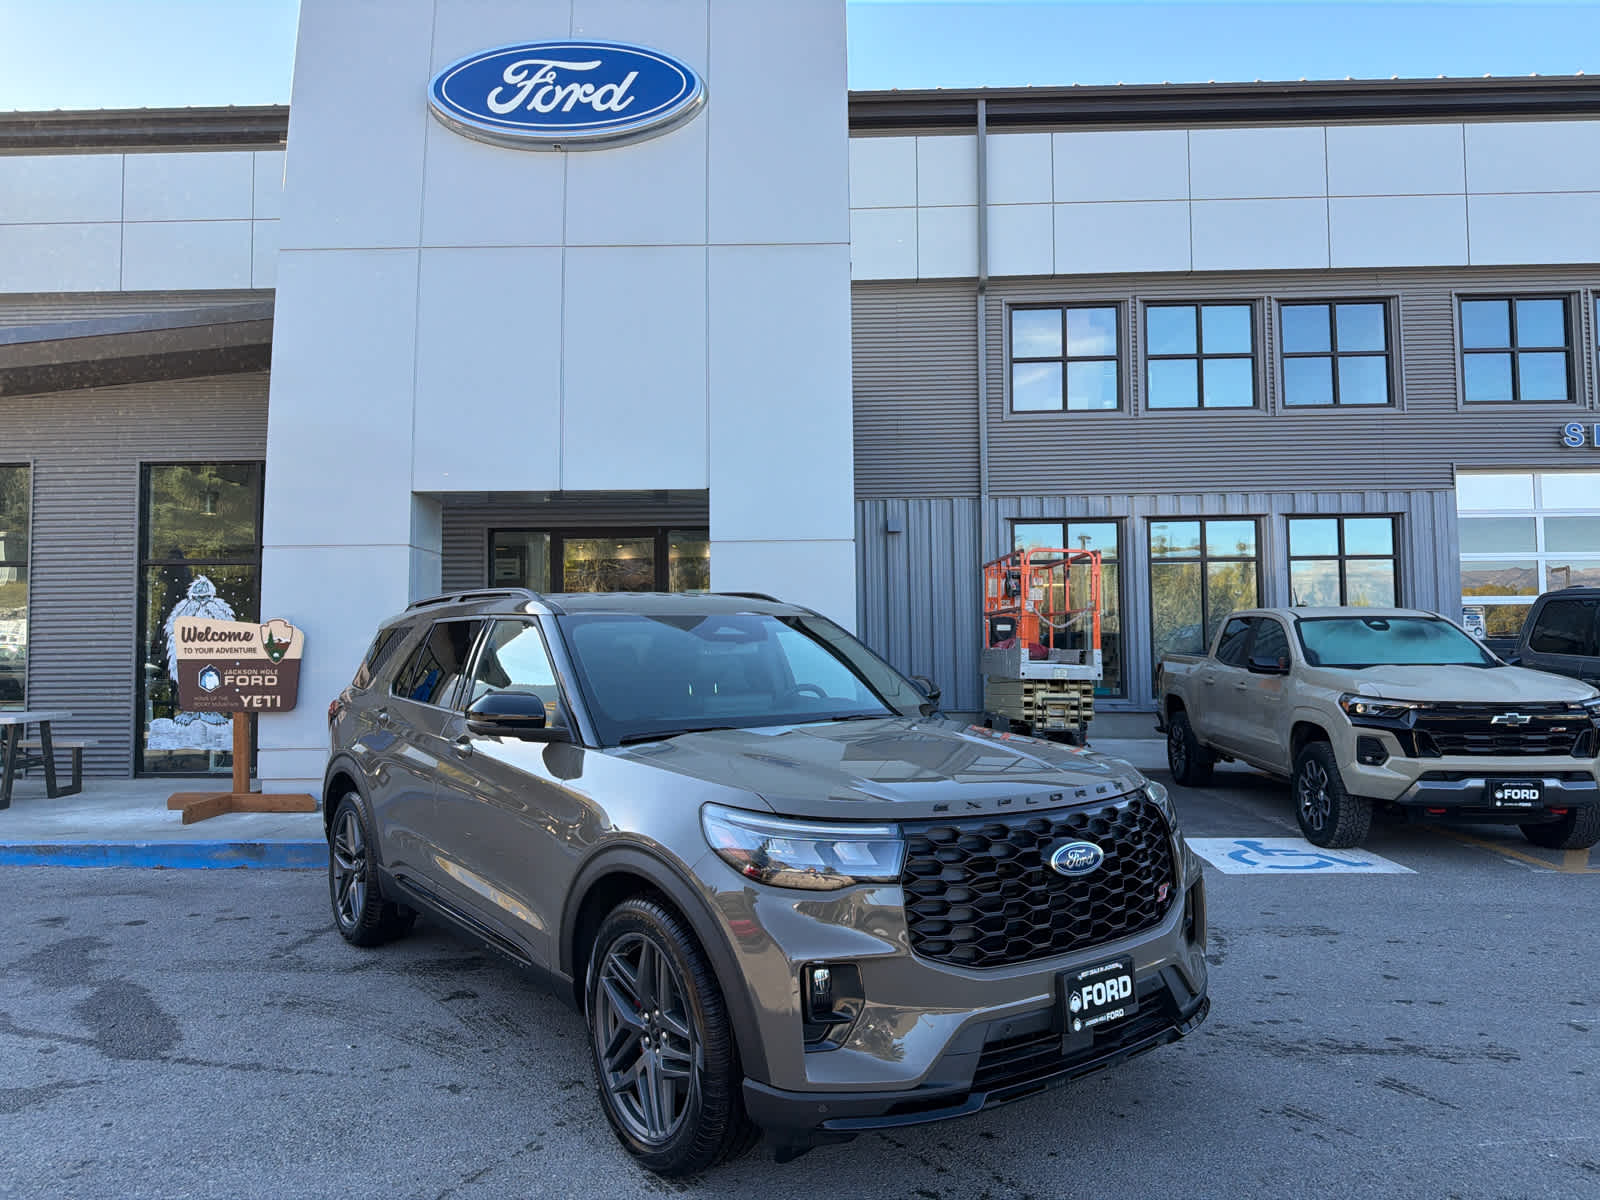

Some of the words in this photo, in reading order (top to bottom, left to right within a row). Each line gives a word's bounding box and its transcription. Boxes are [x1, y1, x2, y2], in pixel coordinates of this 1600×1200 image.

[487, 59, 639, 114] Ford
[1564, 423, 1600, 447] S
[181, 626, 254, 643] Welcome
[224, 675, 278, 686] FORD
[240, 695, 281, 707] YETI
[933, 782, 1123, 812] EXPLORER
[1504, 789, 1539, 800] FORD
[1065, 849, 1094, 868] Ford
[1082, 975, 1132, 1010] FORD
[1106, 1008, 1124, 1021] FORD
